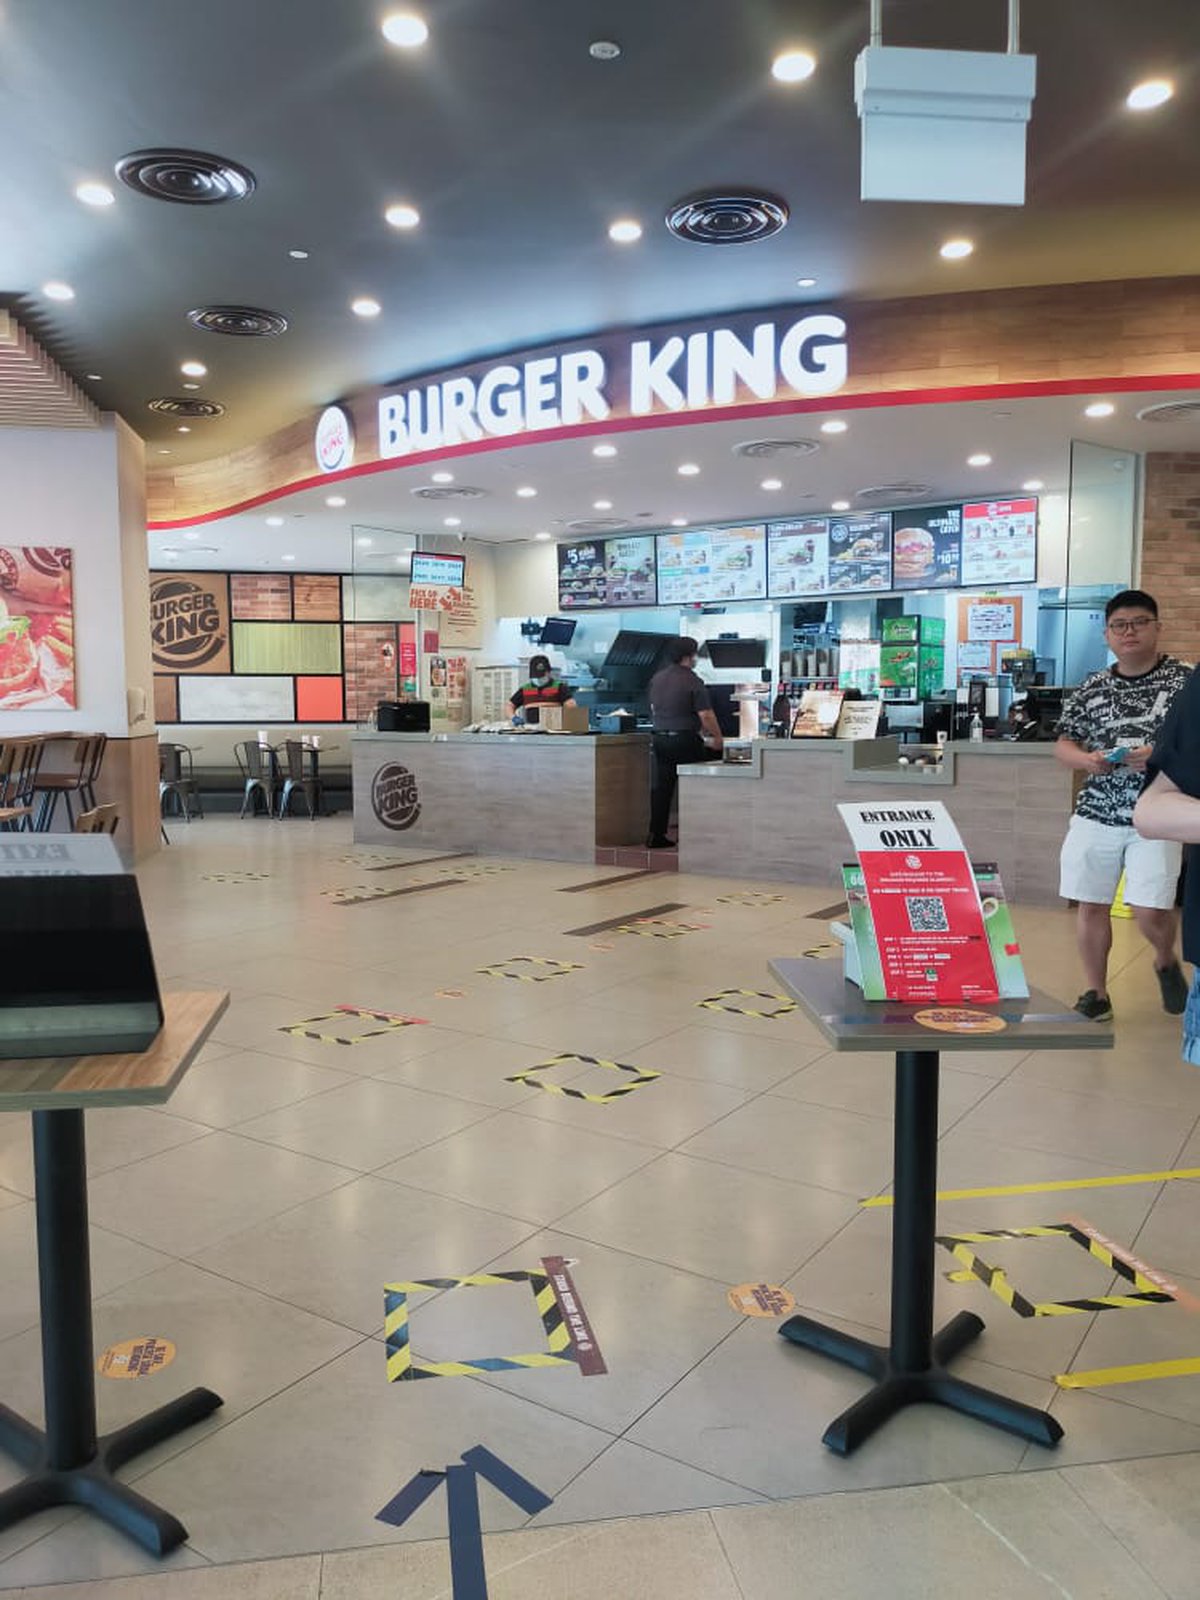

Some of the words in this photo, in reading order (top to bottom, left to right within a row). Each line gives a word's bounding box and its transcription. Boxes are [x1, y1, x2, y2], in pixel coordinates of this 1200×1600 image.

[377, 350, 612, 459] BURGER
[630, 315, 848, 415] KING
[152, 593, 216, 620] URGER
[409, 597, 438, 609] HERE
[860, 809, 936, 823] ENTRANCE
[879, 828, 935, 848] ONLY
